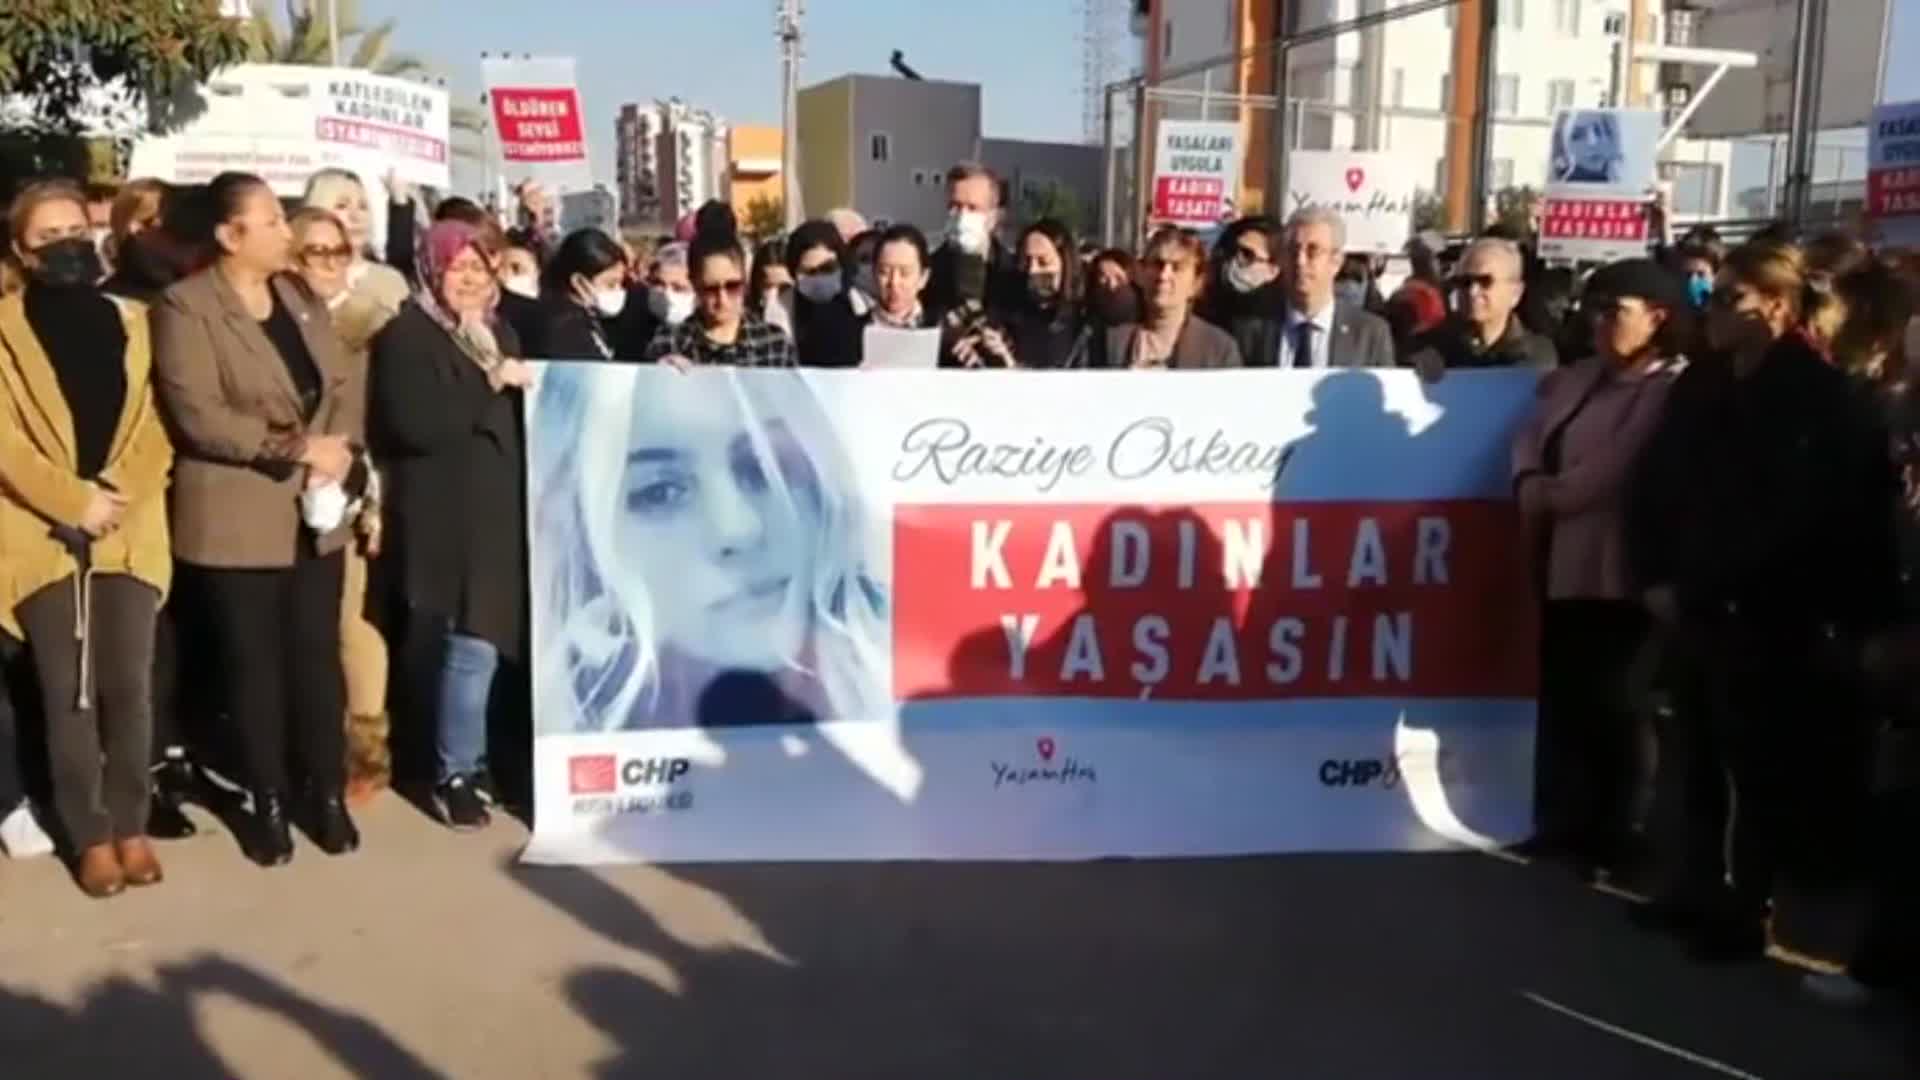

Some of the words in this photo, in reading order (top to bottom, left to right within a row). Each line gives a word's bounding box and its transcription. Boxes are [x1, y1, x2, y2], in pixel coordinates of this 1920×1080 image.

[335, 100, 424, 129] KADINLAR
[890, 417, 1098, 492] Raziye
[1106, 416, 1297, 490] Oskay
[969, 517, 1452, 589] KADINLAR
[1001, 611, 1414, 700] YAŞASIN
[621, 757, 691, 785] CHP
[1319, 758, 1383, 786] CHP
